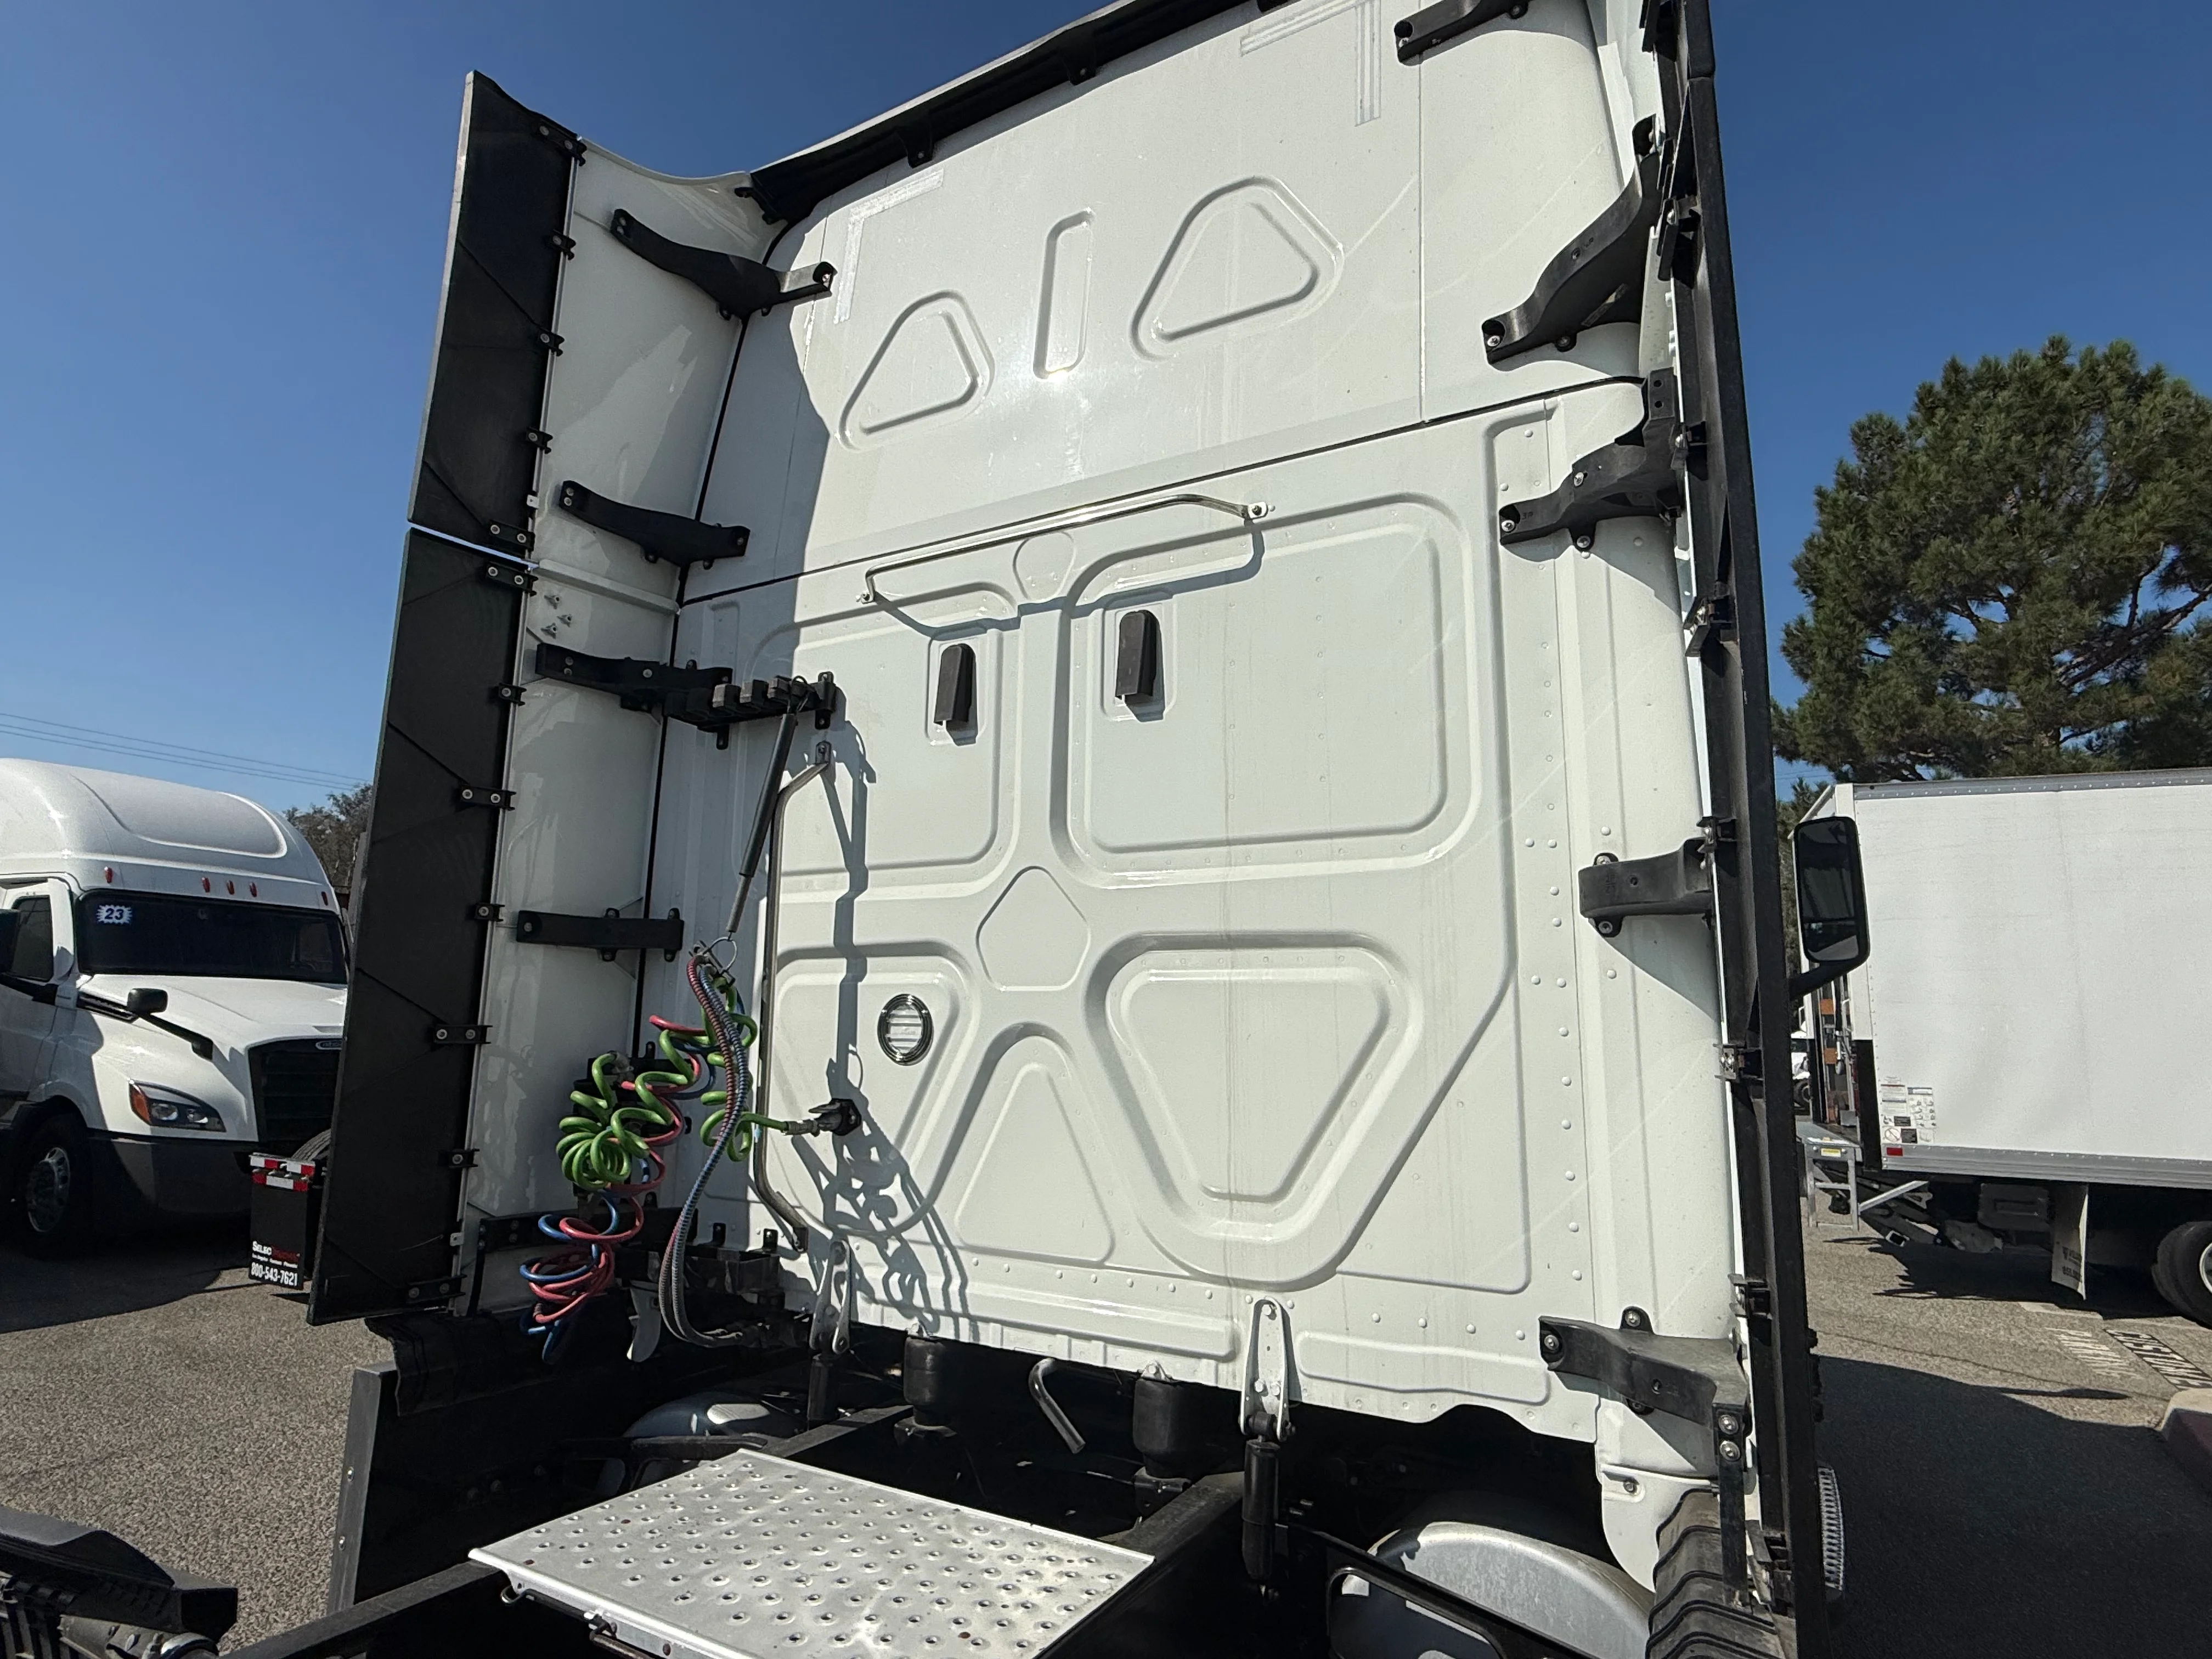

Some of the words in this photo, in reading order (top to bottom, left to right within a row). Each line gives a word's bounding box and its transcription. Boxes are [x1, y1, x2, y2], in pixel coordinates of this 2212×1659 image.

[104, 907, 124, 921] 23
[251, 1262, 297, 1286] 800-543-7621
[2106, 1329, 2212, 1389] CUSTOME
